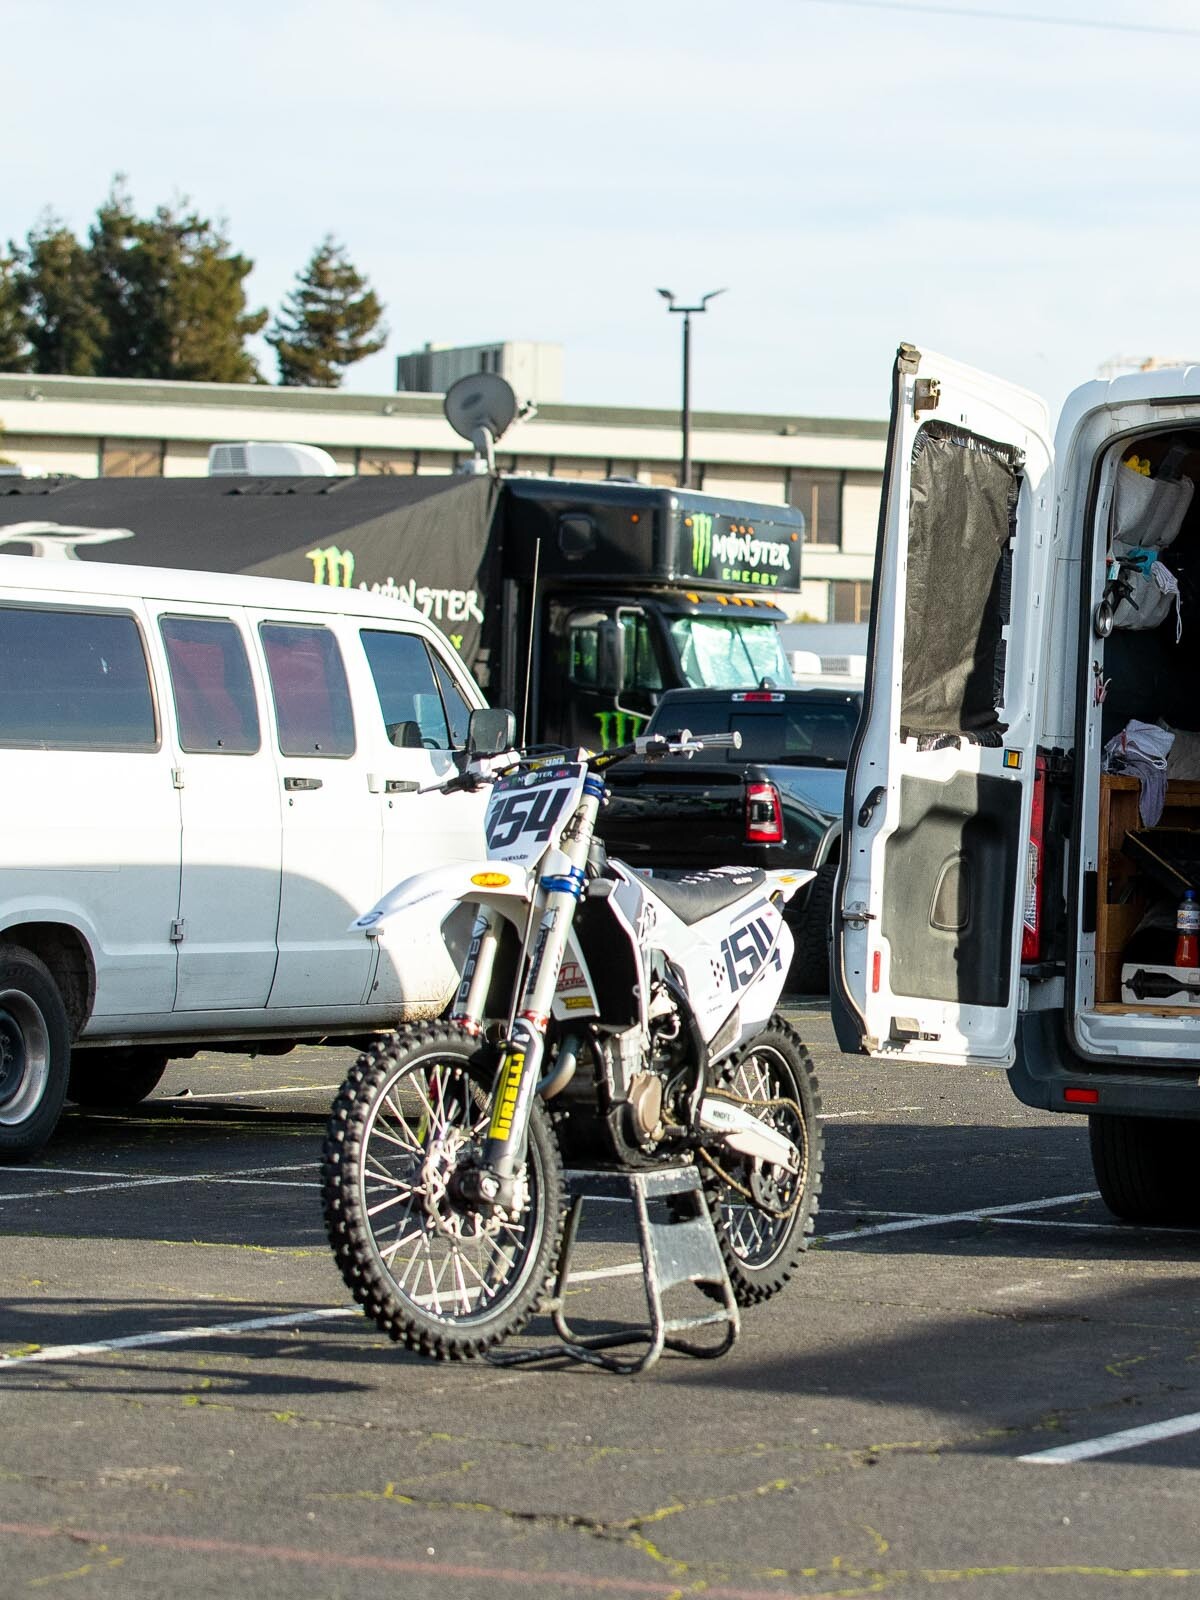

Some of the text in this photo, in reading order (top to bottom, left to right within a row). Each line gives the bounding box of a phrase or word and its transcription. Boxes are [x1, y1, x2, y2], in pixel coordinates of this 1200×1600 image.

[712, 532, 791, 571] MONSTER
[722, 568, 778, 586] ENERGY
[360, 577, 484, 624] ONSTER
[485, 787, 572, 850] 154
[720, 917, 782, 993] 154
[488, 1053, 525, 1140] PIRELLI
